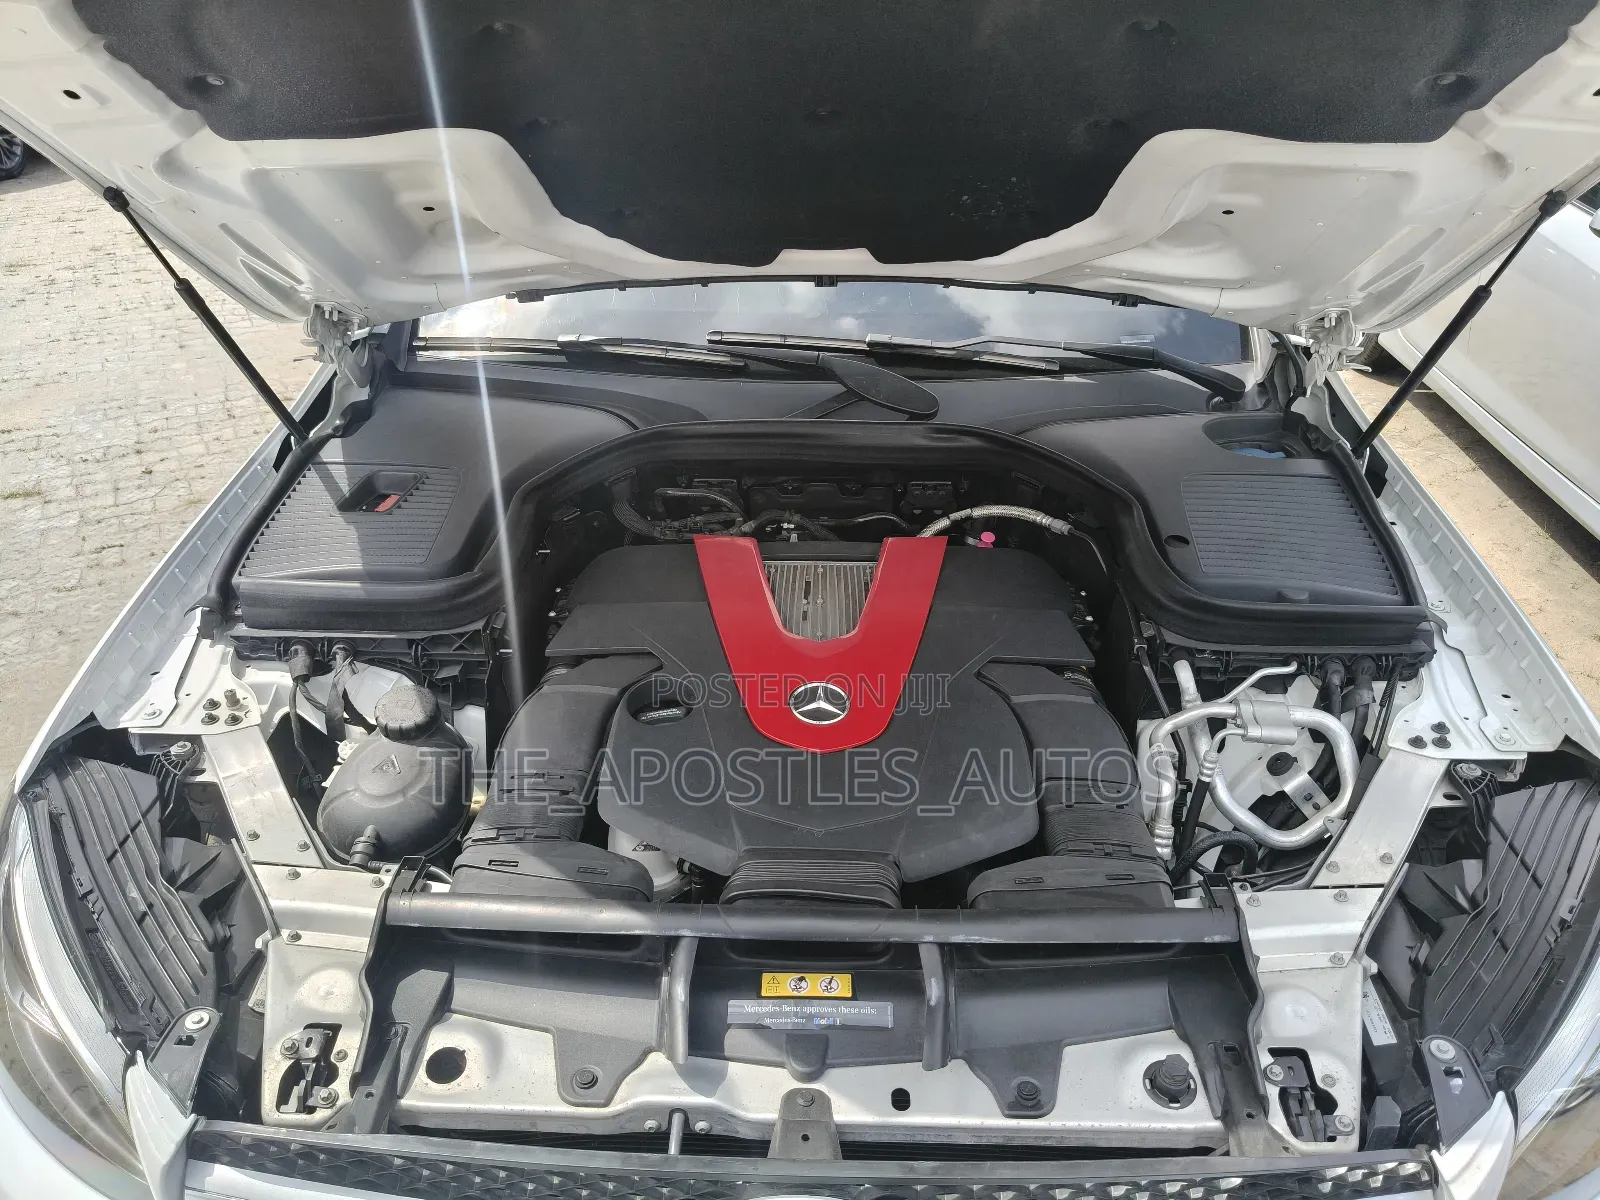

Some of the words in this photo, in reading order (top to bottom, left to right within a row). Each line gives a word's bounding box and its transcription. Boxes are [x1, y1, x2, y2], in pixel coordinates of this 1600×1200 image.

[743, 1004, 801, 1013] Mercedes-Benz
[802, 1006, 837, 1014] approves
[838, 1006, 859, 1014] these
[860, 1007, 878, 1015] oils:
